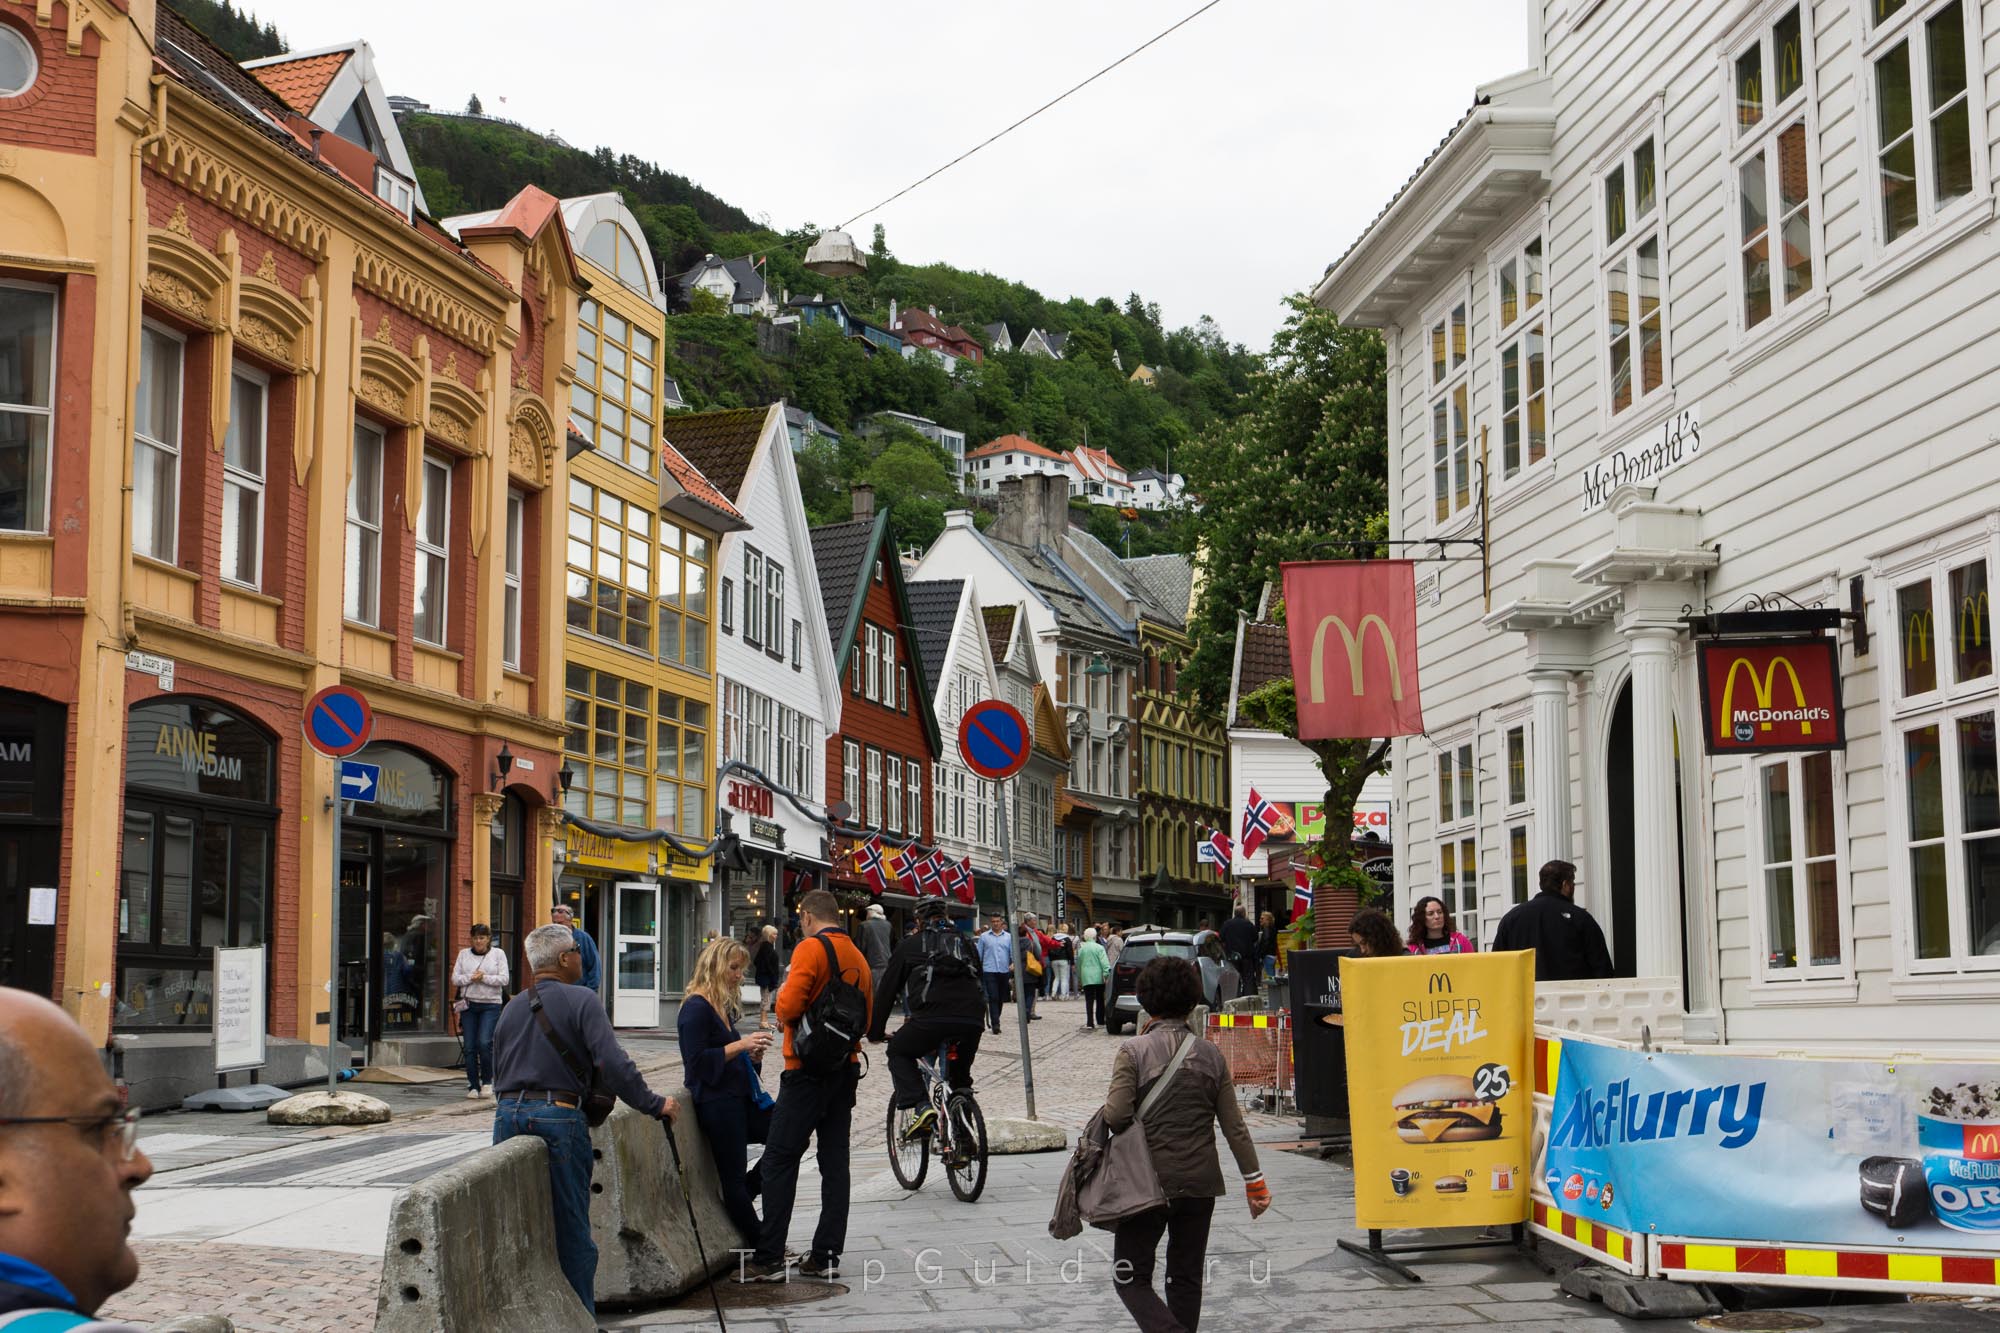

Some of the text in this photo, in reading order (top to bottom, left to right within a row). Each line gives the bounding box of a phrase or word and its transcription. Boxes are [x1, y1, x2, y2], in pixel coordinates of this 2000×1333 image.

[1583, 411, 1700, 512] McDonald's
[1734, 706, 1830, 722] McDonald's
[155, 724, 217, 765] ANNE
[182, 748, 241, 781] MADAM
[381, 789, 424, 811] MADAM
[1302, 806, 1388, 826] Pza
[571, 829, 614, 860] NATALIE
[1057, 881, 1065, 918] KAFFE
[164, 979, 212, 999] RESTAURAN
[1403, 998, 1482, 1023] SUPER
[1400, 1008, 1488, 1057] DEAL
[1551, 1077, 1767, 1149] McFlurry
